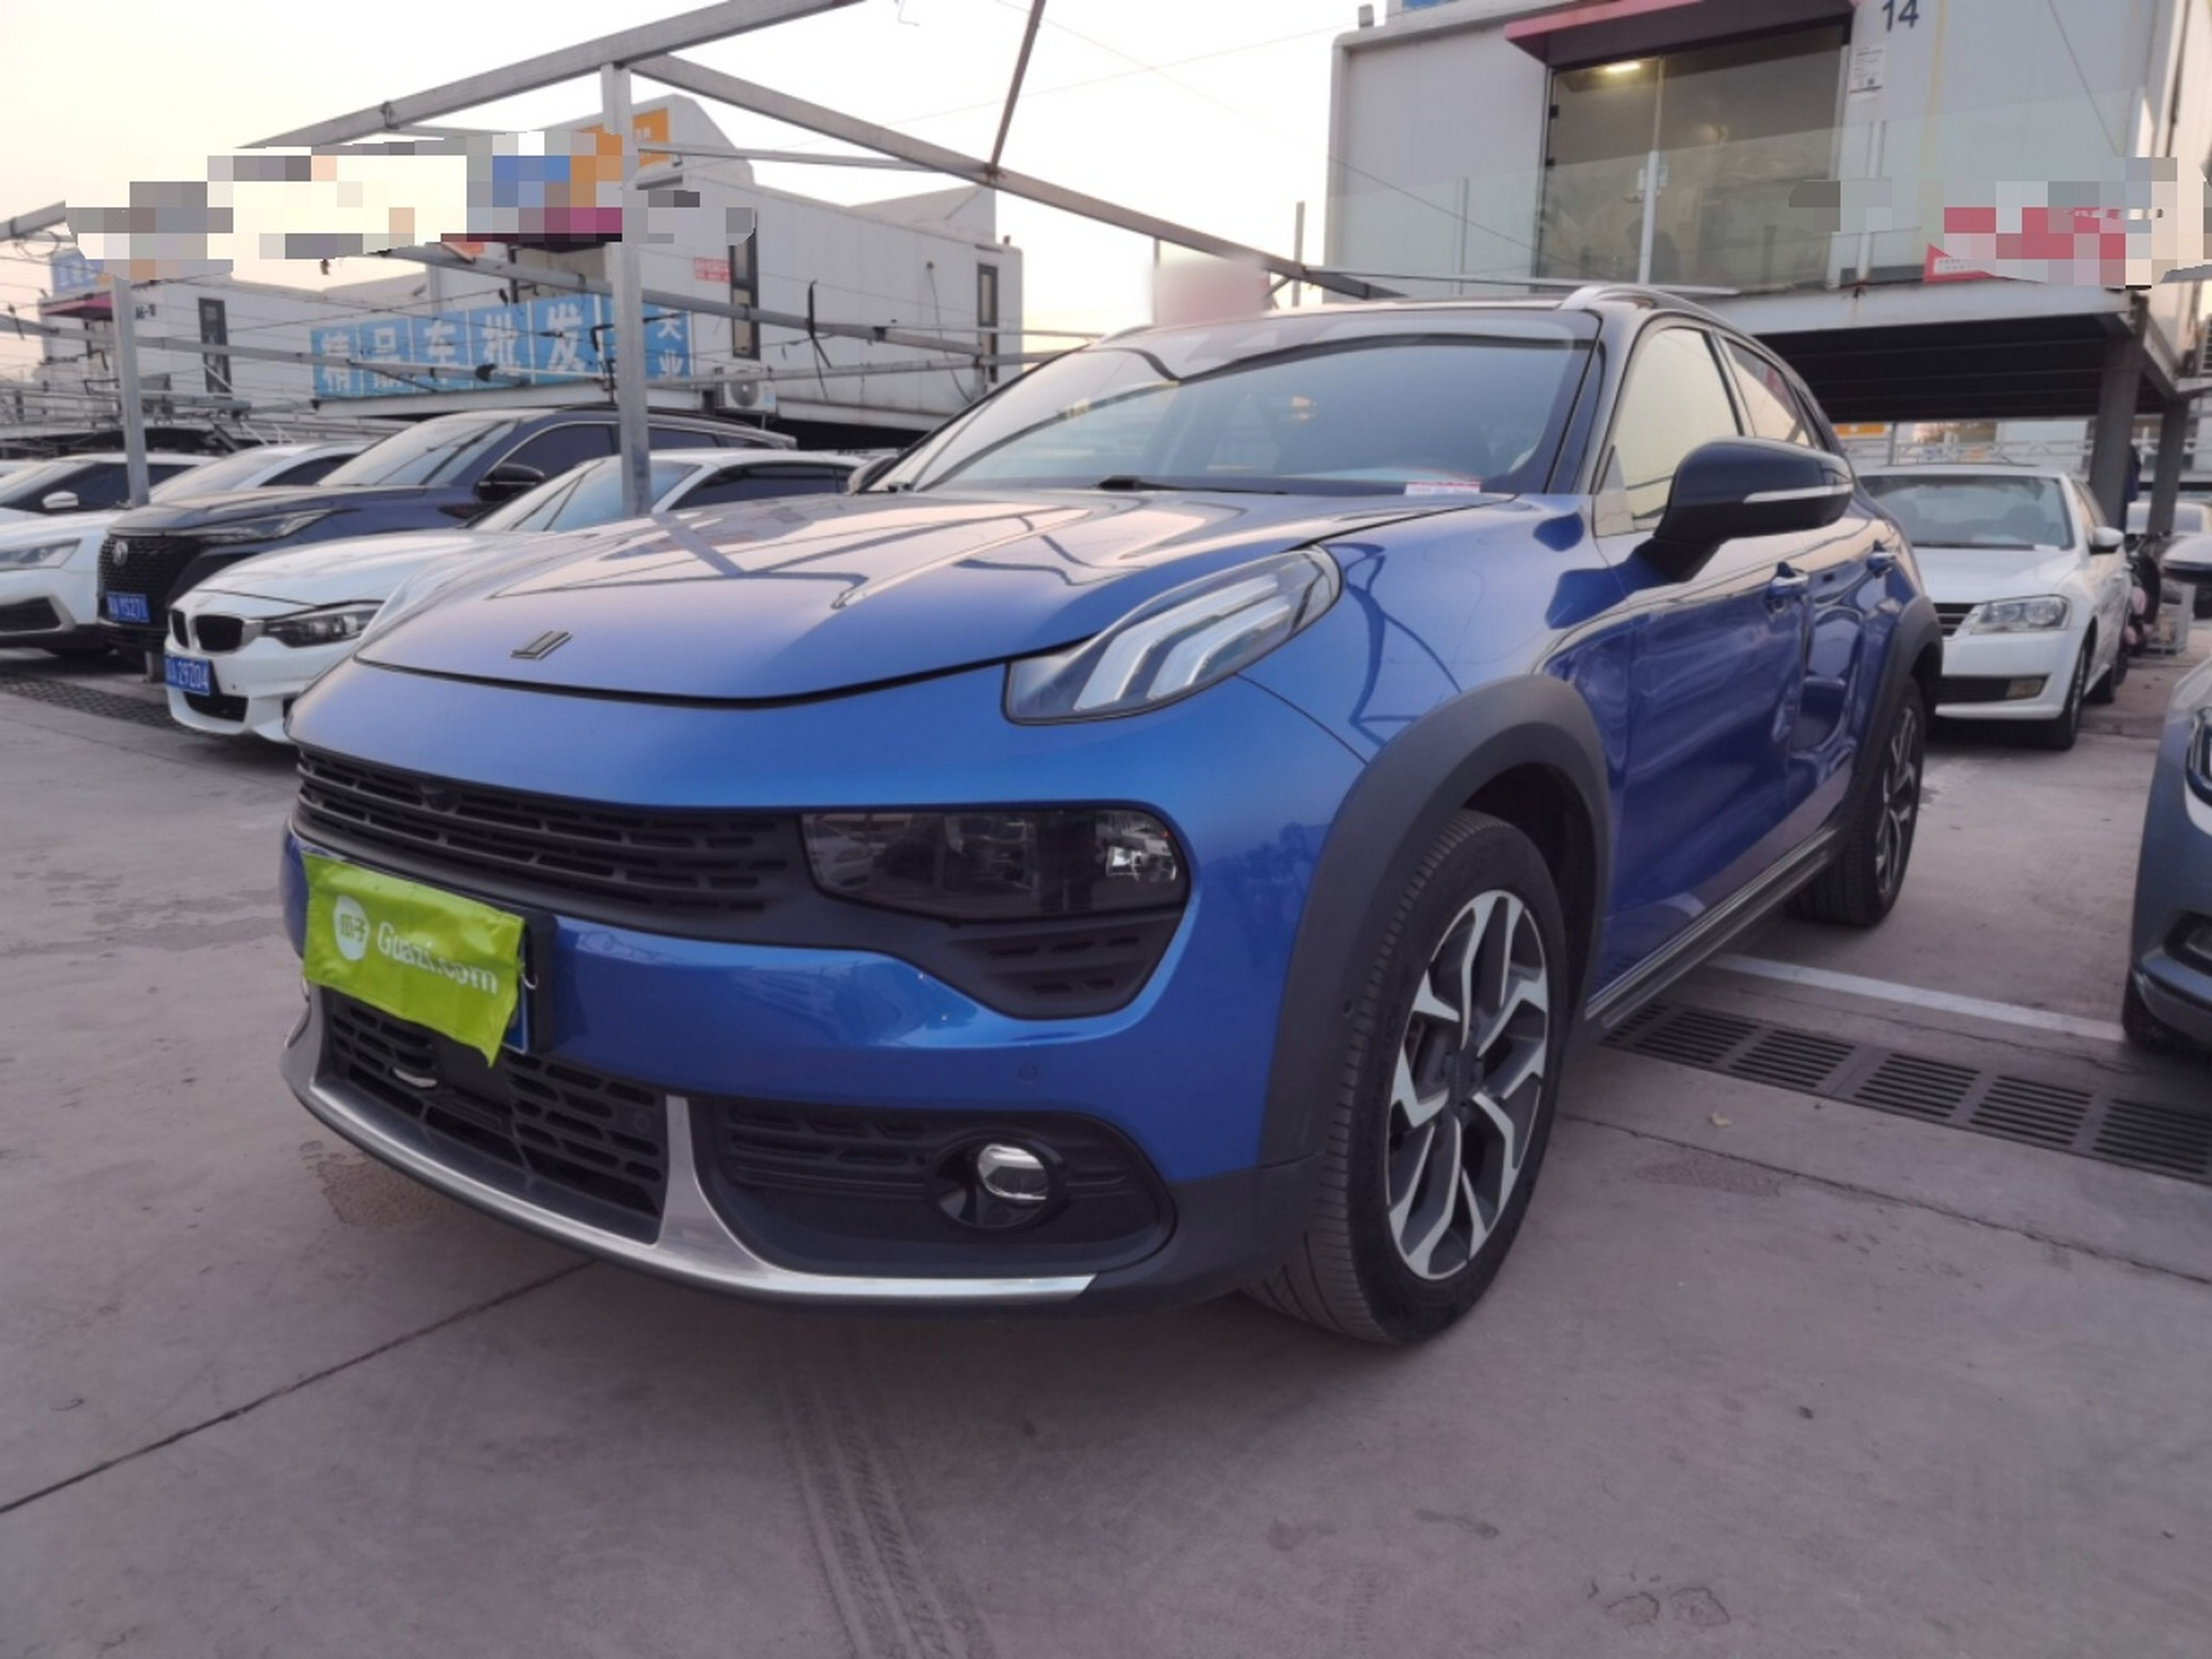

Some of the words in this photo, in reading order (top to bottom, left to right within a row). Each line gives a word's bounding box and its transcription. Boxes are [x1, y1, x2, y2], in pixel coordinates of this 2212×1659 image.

[1882, 0, 1919, 33] 14
[321, 302, 586, 392] 精品车批发
[340, 914, 366, 943] 瓜子
[378, 921, 498, 995] Guazi.com
